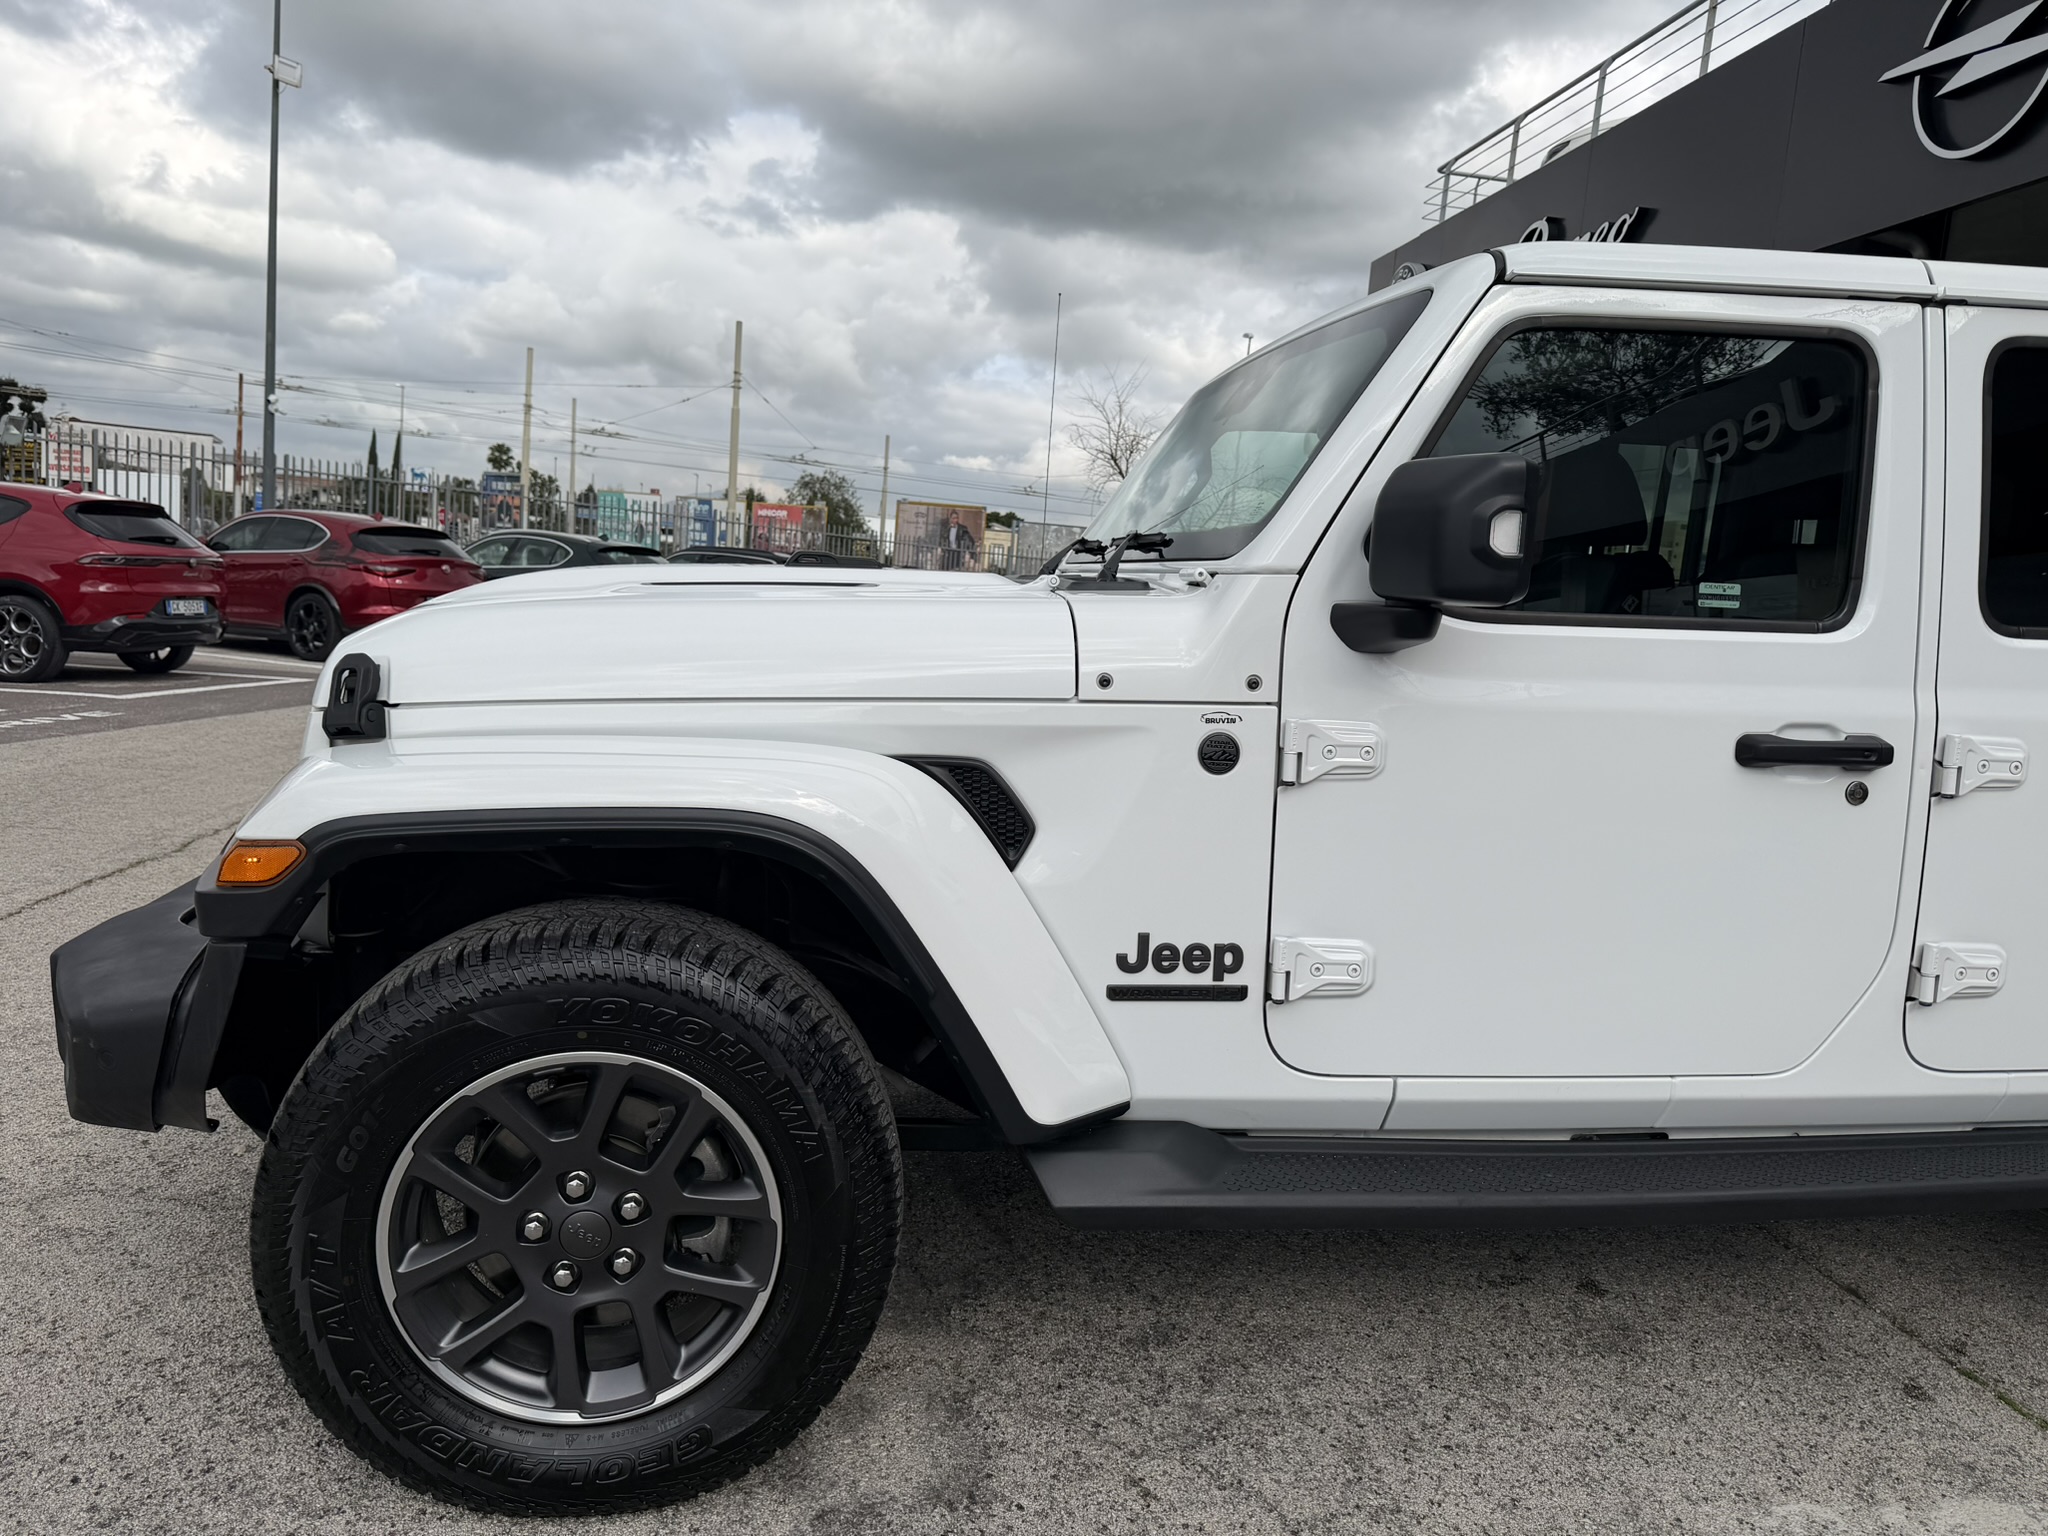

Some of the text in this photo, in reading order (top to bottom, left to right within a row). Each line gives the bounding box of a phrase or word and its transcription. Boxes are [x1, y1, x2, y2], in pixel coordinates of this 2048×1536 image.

[1110, 987, 1212, 998] WRANGLER
[1115, 932, 1245, 981] Jeep
[546, 996, 825, 1164] YOKOHAMA
[568, 1222, 601, 1247] Jeep
[307, 1232, 355, 1341] A/T
[350, 1362, 714, 1487] GEOLANDAR
